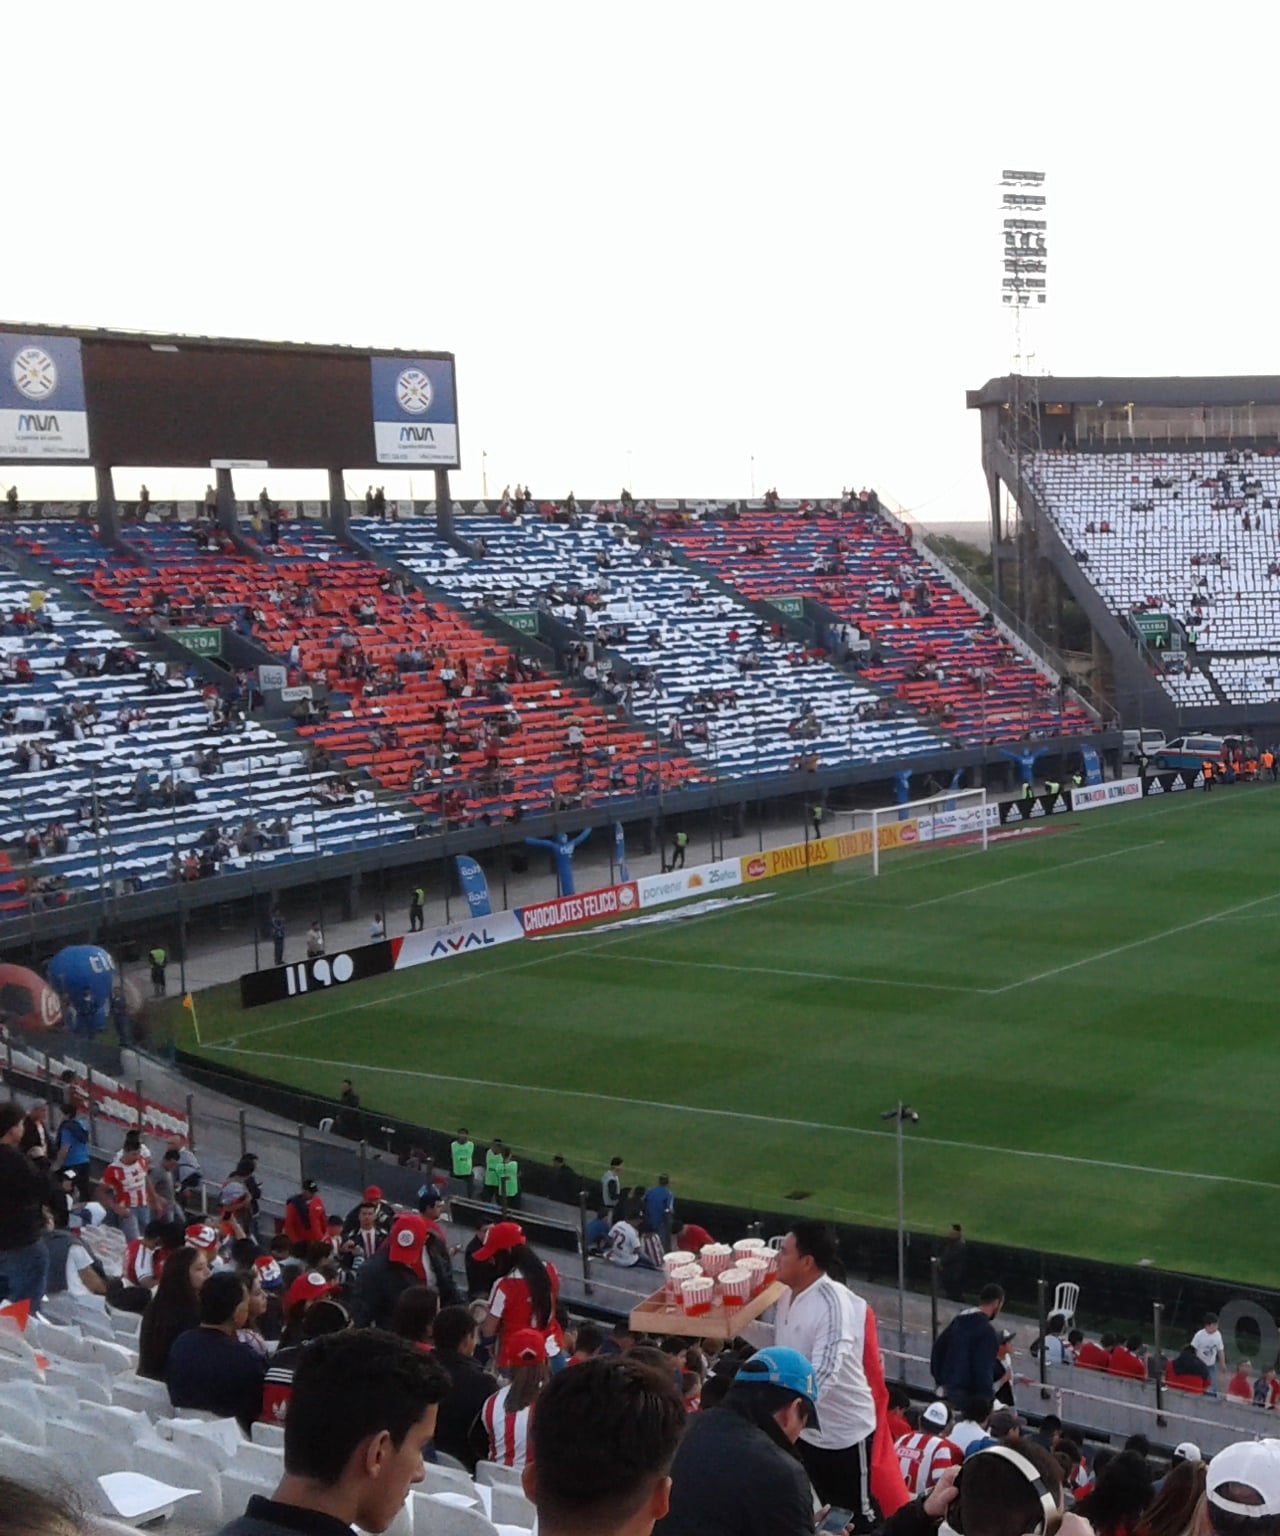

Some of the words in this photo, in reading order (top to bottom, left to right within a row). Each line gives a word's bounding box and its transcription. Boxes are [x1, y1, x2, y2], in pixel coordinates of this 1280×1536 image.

[772, 842, 828, 873] PINTURAS
[643, 880, 683, 901] porvenir
[523, 901, 583, 932] CHOCOLATES
[583, 889, 618, 917] FELICCI
[430, 928, 495, 957] AVAL
